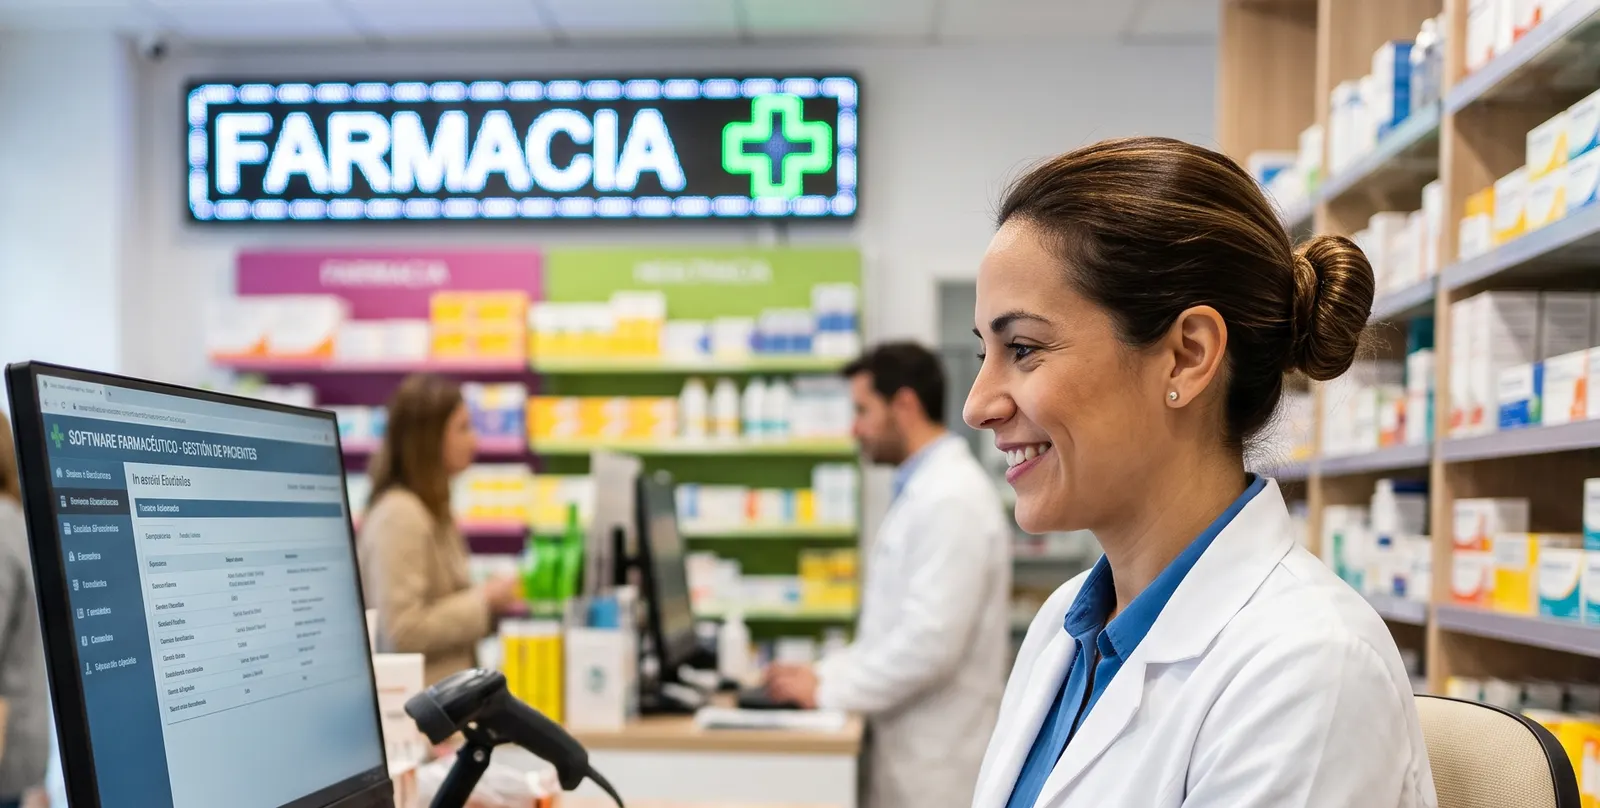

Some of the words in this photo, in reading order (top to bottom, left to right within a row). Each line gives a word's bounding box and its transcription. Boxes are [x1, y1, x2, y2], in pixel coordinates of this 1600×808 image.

[215, 109, 686, 193] FARMACIA
[68, 430, 118, 448] SOFTWARE
[118, 435, 178, 454] FARMACÉUTICO
[182, 441, 213, 457] GESTIÓN
[213, 445, 222, 458] DE
